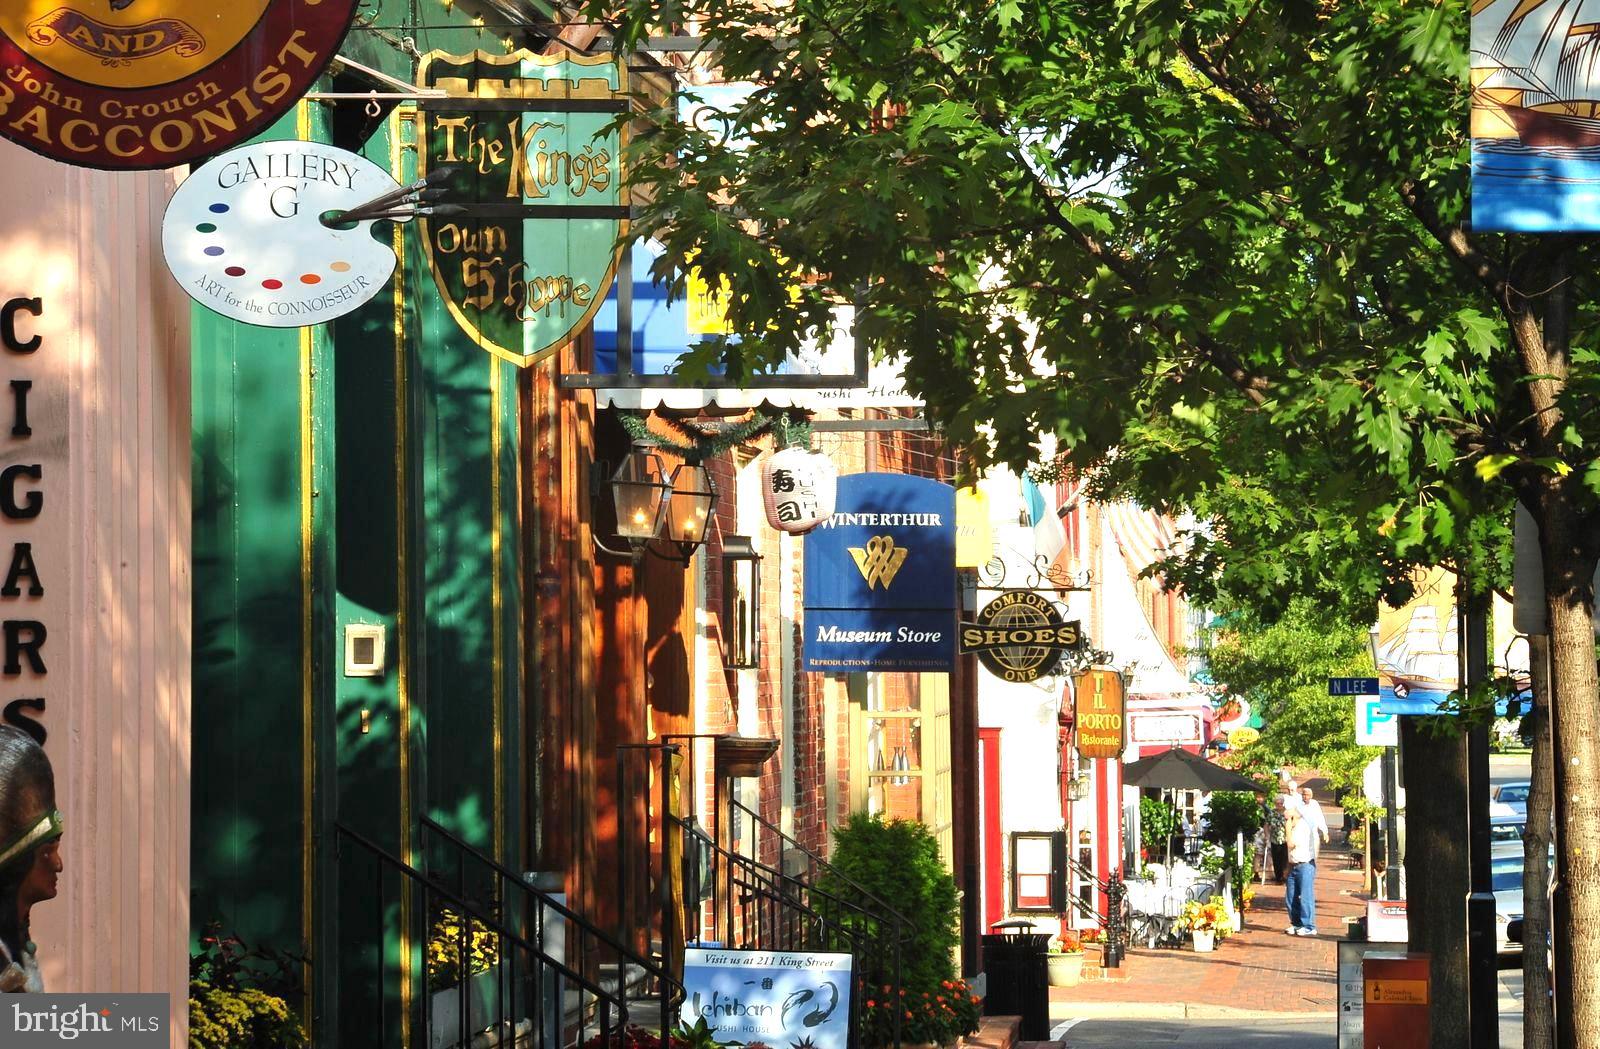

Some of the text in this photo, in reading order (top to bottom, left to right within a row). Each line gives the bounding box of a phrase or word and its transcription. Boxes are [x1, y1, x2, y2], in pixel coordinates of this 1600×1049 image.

[67, 25, 165, 52] AND
[6, 66, 221, 118] John Crouch
[433, 114, 611, 198] The King's
[218, 153, 360, 191] GALLERY
[195, 274, 370, 316] ART for the CONNOISSEUR
[462, 257, 591, 321] Shoppe
[0, 297, 48, 748] CIGARS
[821, 512, 943, 530] WINTERTHUR
[984, 593, 1056, 619] COMFORT
[816, 625, 942, 643] Museum Store
[964, 627, 1077, 647] SHOES
[1004, 668, 1038, 682] ONE
[1333, 680, 1367, 694] N LEE
[1077, 713, 1122, 730] PORTO
[1081, 733, 1120, 746] Ristorante
[704, 953, 834, 969] Visit us at 211 King Street
[692, 990, 773, 1018] Ichiban
